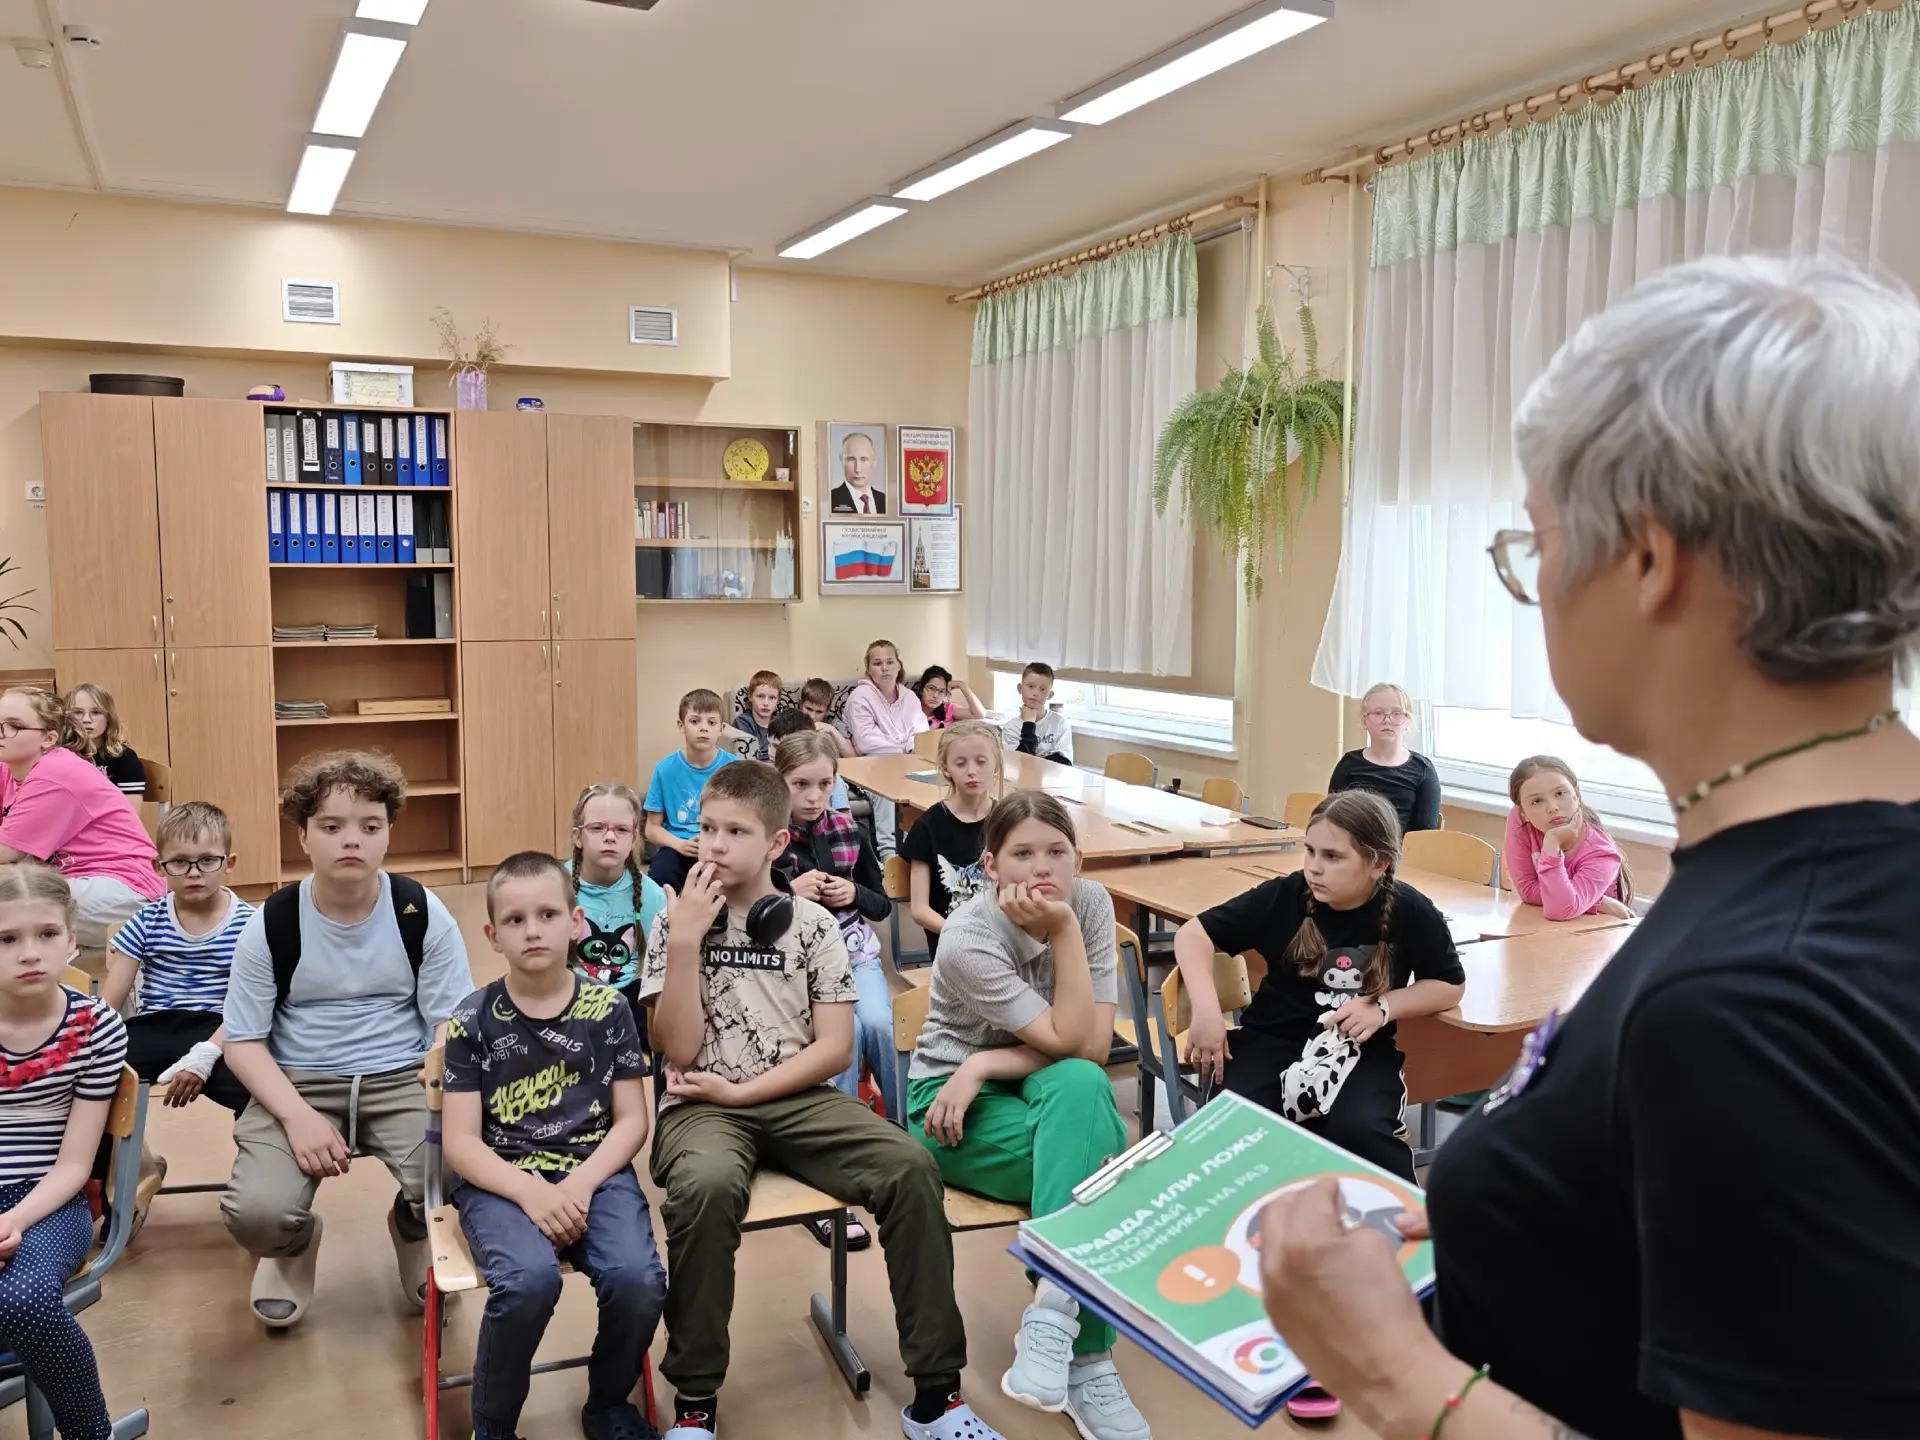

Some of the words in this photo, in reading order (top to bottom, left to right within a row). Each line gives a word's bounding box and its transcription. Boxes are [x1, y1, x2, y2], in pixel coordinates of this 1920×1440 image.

[710, 950, 732, 963] NO
[734, 951, 781, 967] LIMITS
[537, 1026, 584, 1053] STREET
[488, 1048, 511, 1062] ABOU
[559, 1071, 581, 1088] the
[1064, 1208, 1155, 1256] ПРАВДА
[1151, 1172, 1202, 1208] ИЛИ
[1200, 1127, 1270, 1175] ЛОЖЬ:
[1207, 1186, 1237, 1206] НА
[1234, 1163, 1270, 1187] РАЗ
